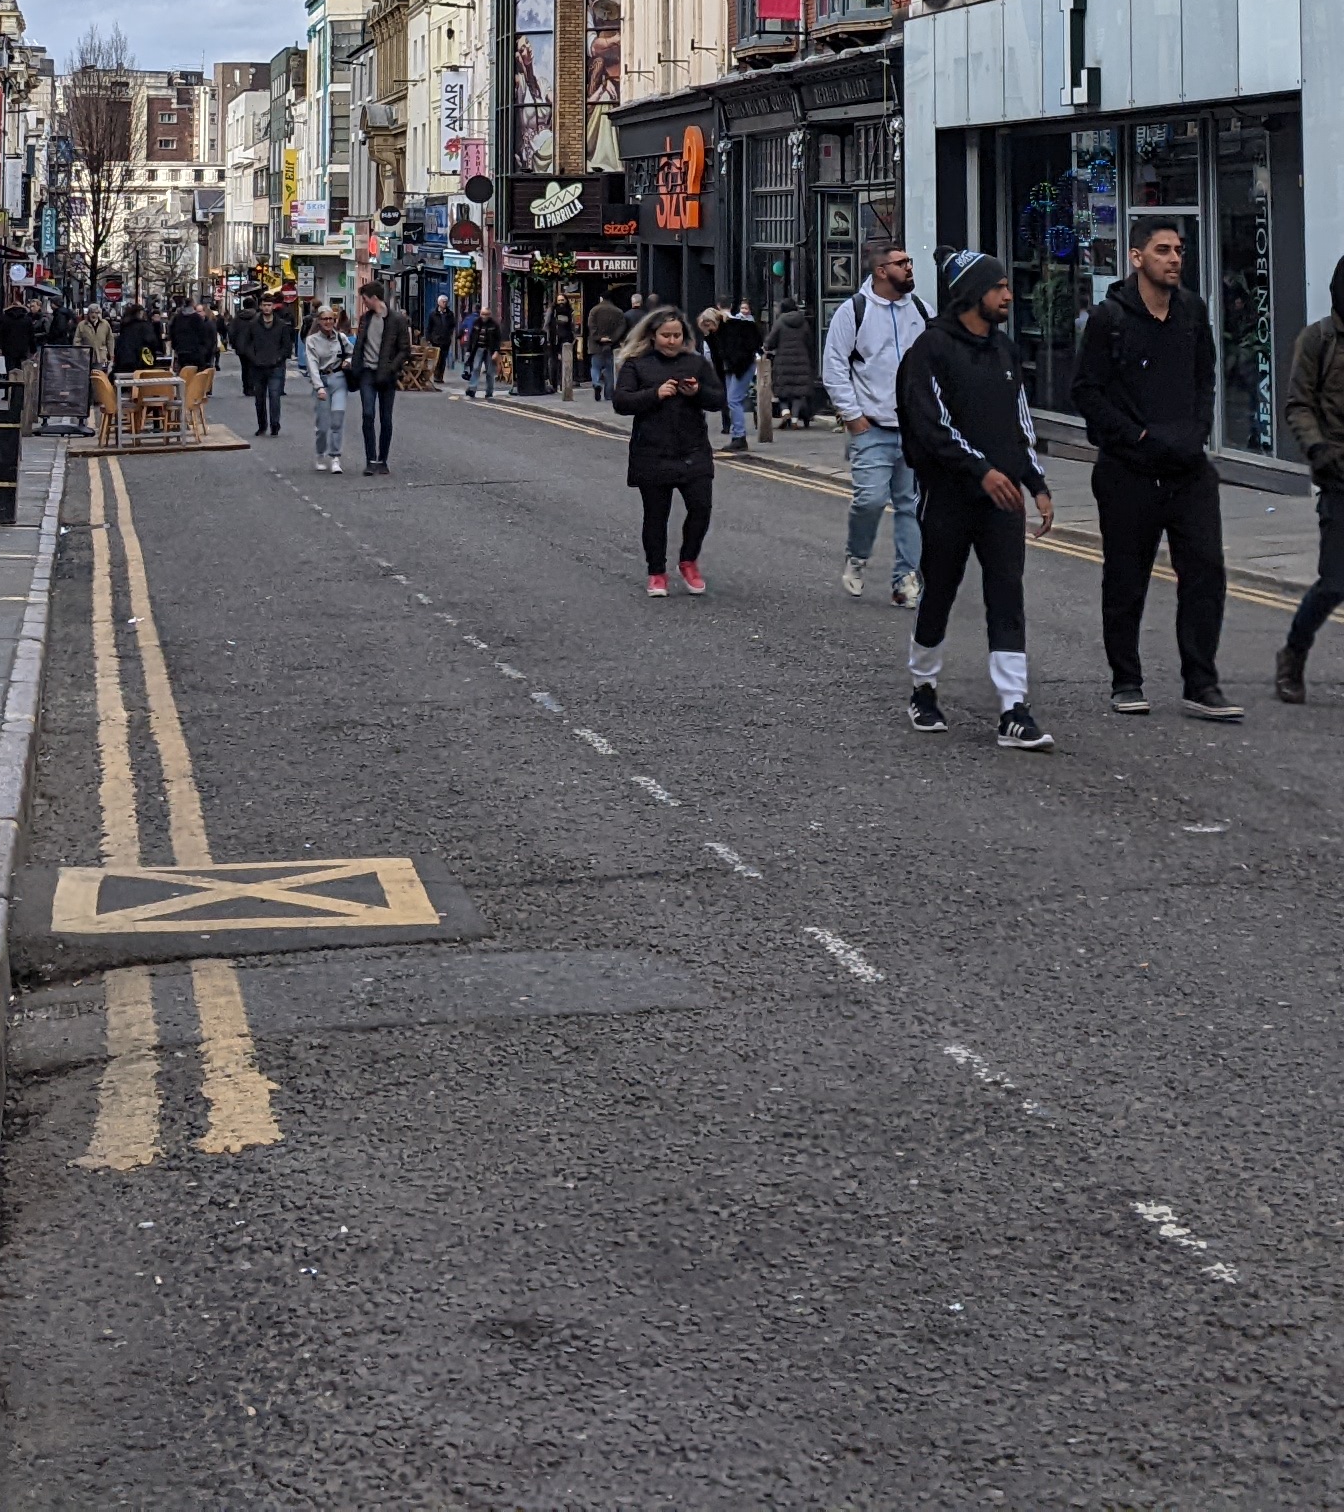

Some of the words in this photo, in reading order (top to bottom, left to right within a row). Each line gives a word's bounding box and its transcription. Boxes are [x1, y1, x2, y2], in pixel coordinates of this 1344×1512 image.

[444, 83, 459, 132] ANAR
[534, 215, 546, 230] LA
[545, 198, 584, 228] PARRILLA
[603, 220, 637, 235] size?
[588, 260, 601, 271] LA
[1256, 286, 1271, 344] ON
[1257, 352, 1272, 448] LEAF
